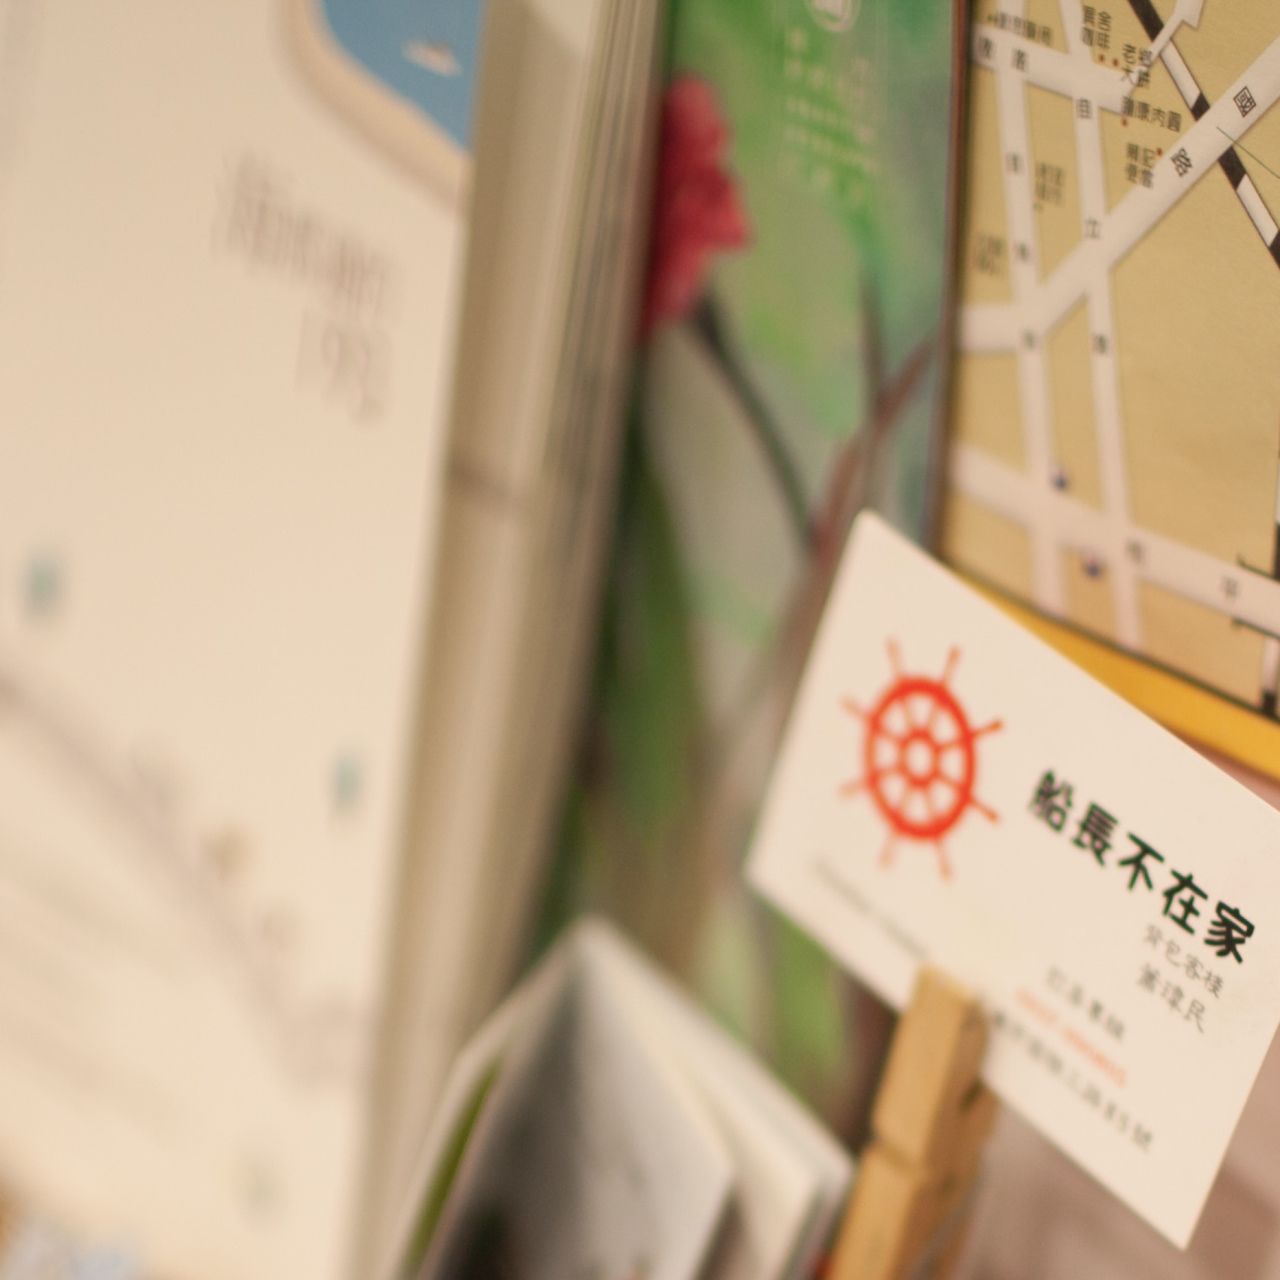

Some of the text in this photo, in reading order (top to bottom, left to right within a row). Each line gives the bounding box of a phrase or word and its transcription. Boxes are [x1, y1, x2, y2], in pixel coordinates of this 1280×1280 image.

[1028, 769, 1257, 966] 船長不在家
